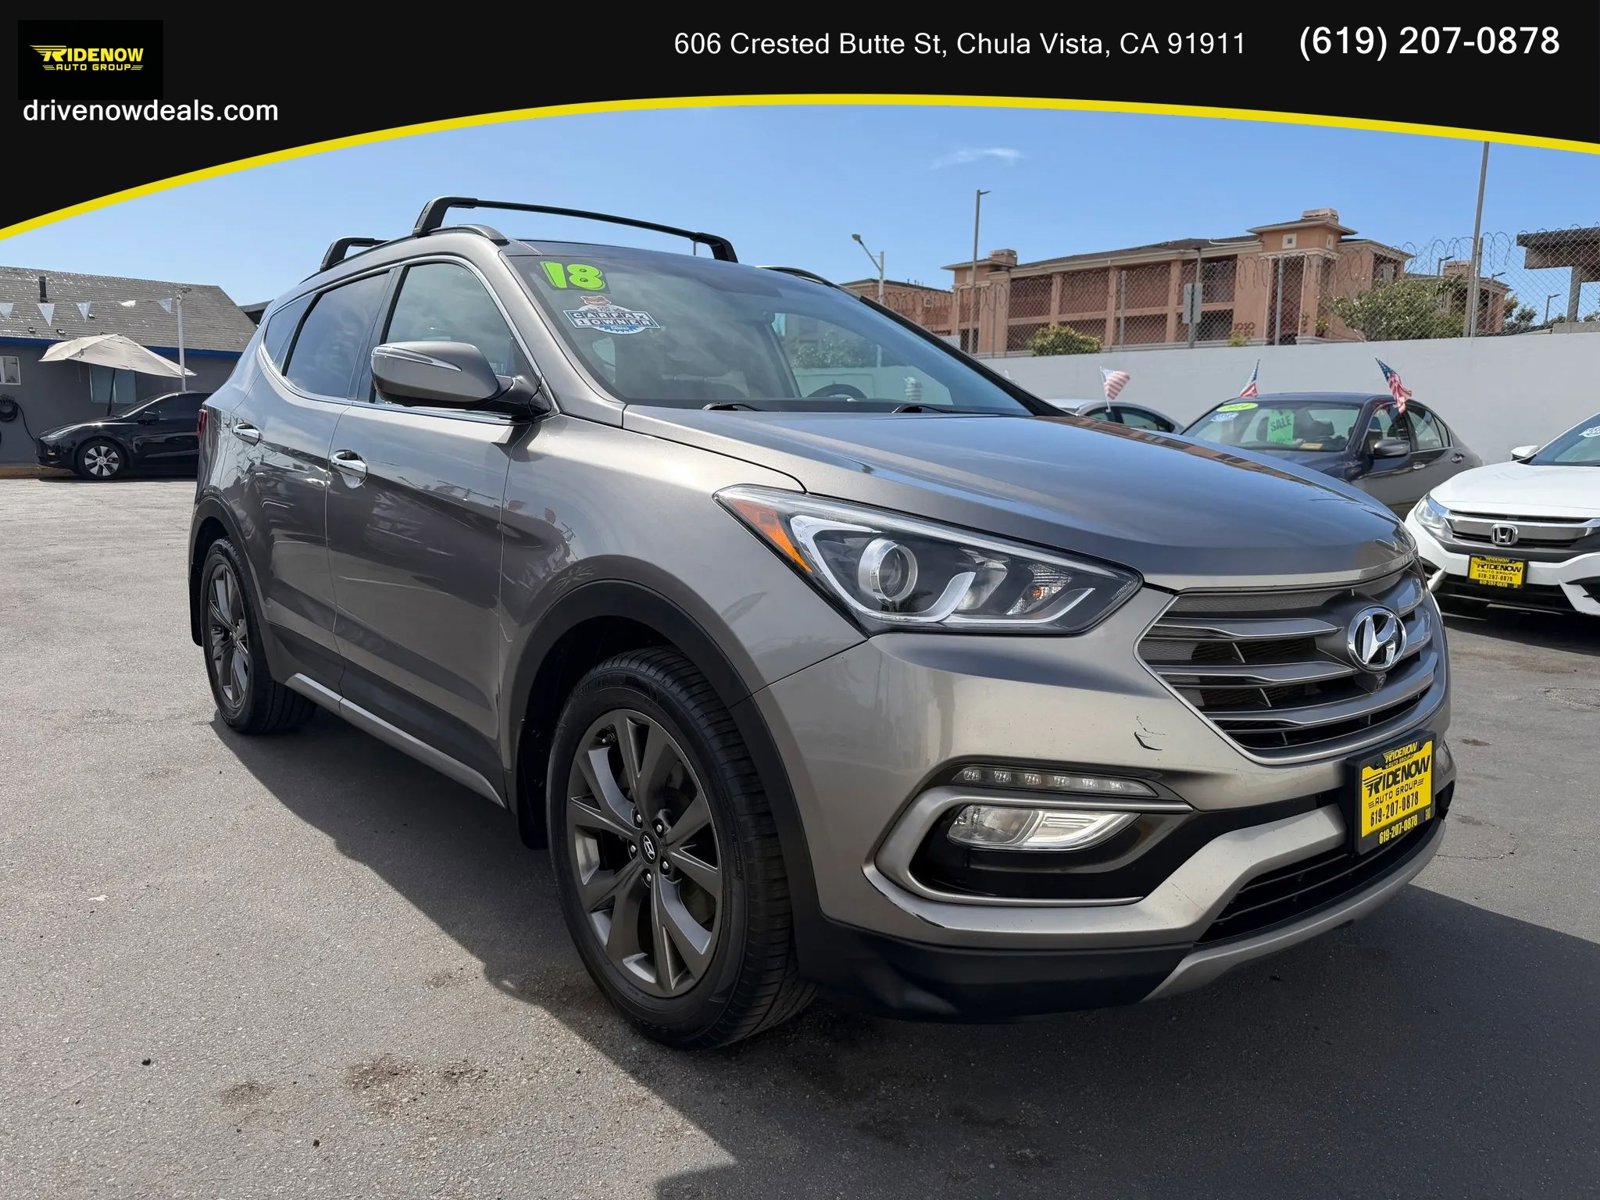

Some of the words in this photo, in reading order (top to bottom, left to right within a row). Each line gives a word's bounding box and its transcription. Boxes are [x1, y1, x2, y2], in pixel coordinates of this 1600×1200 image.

[539, 260, 606, 291] 18
[571, 312, 648, 320] CARFAX
[590, 318, 652, 326] OWNER
[1270, 415, 1293, 432] SALE
[1477, 563, 1522, 572] RIDENOW
[1383, 742, 1418, 763] RIDENOW
[1364, 755, 1431, 797] RIDENOW
[1375, 791, 1393, 806] AUTO
[1396, 779, 1418, 796] GROUP
[1370, 791, 1419, 827] 619-207-0878
[1379, 815, 1418, 845] 619-207-0878
